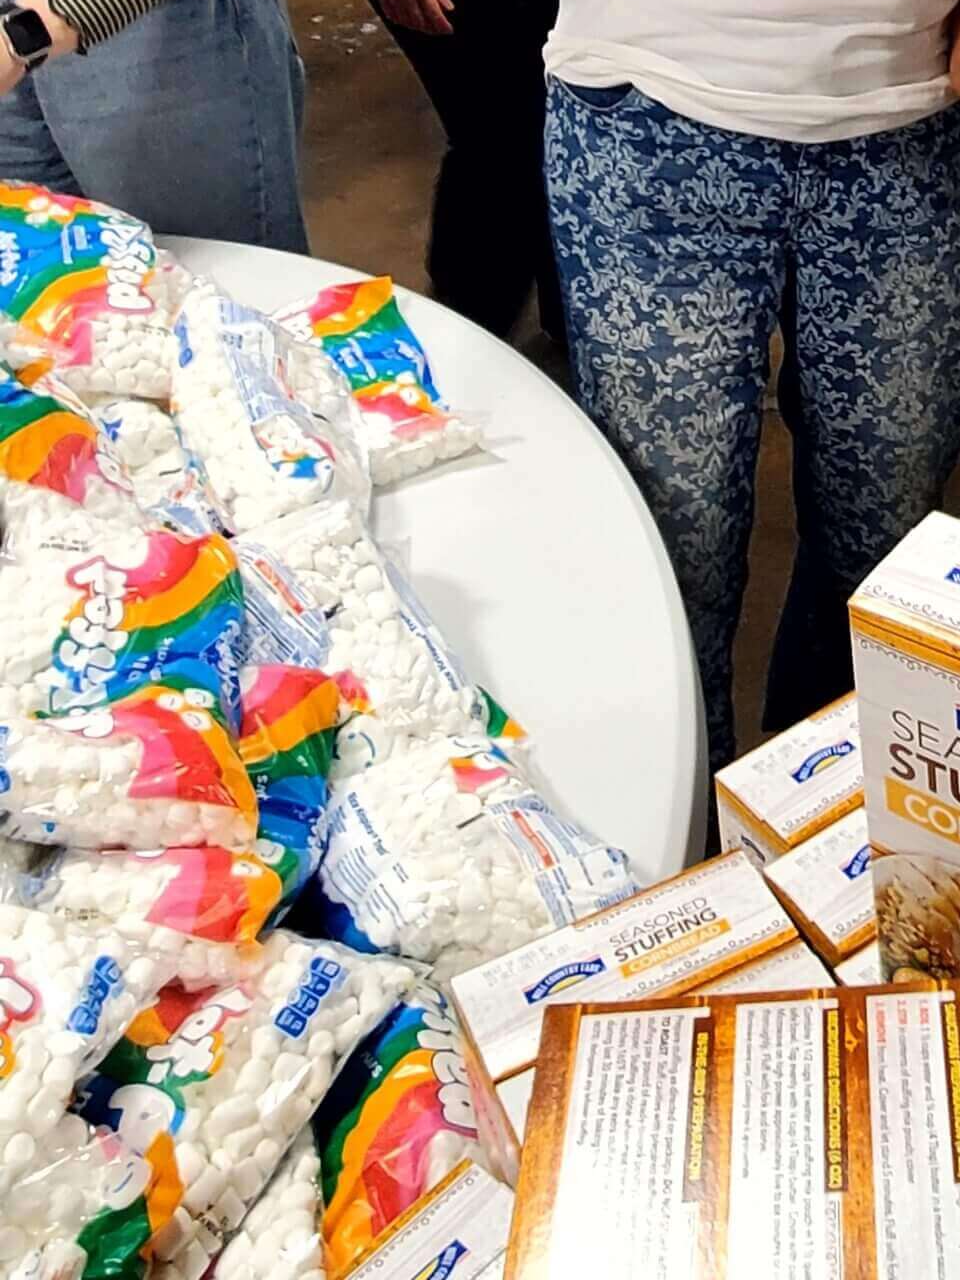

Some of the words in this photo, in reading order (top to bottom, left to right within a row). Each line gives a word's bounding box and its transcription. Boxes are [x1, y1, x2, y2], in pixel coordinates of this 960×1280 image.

[609, 896, 709, 948] SEASONED
[613, 908, 718, 963] STUFFING
[628, 923, 722, 973] CORNBREAD
[827, 1011, 840, 1077] MICROWAVE
[944, 1004, 960, 1059] SAUCEPAN
[828, 1078, 841, 1149] DIRECTIONS
[879, 1088, 889, 1113] Cover
[899, 1079, 912, 1108] stuffing
[688, 1102, 707, 1182] PREPARATION
[881, 1144, 891, 1168] stand
[934, 1215, 946, 1254] medium
